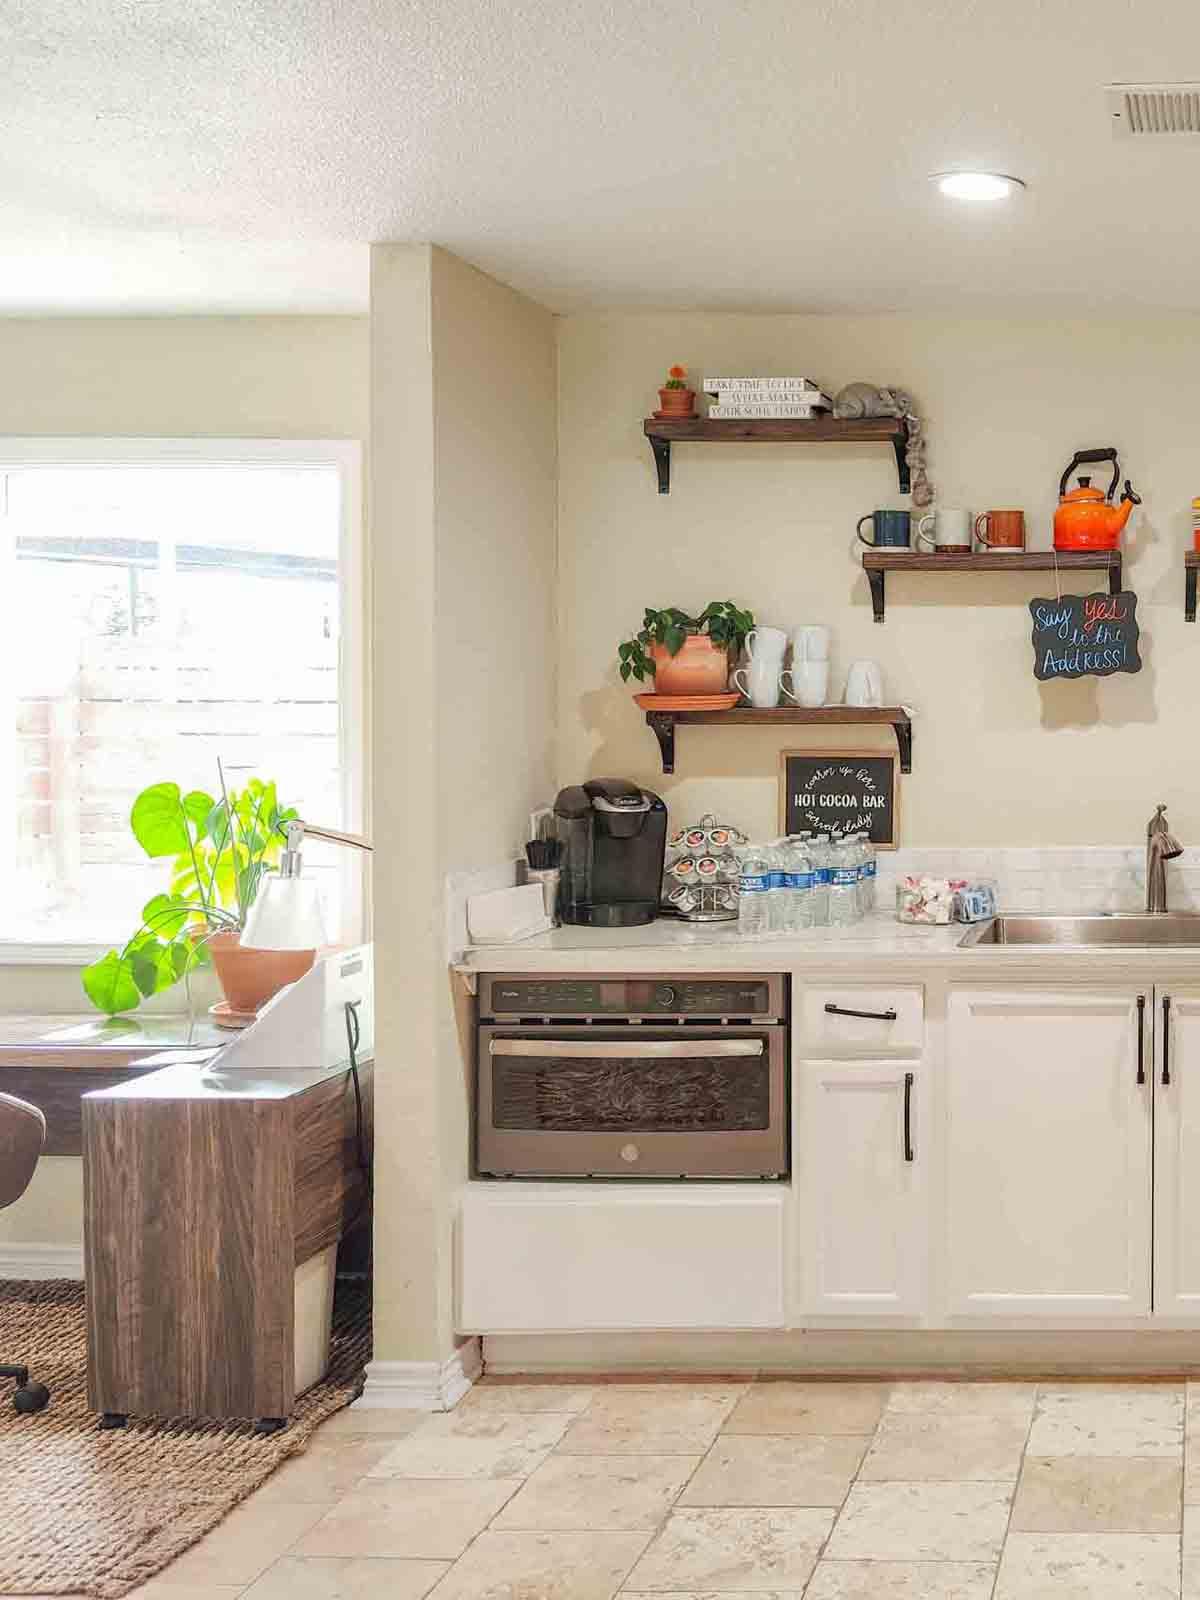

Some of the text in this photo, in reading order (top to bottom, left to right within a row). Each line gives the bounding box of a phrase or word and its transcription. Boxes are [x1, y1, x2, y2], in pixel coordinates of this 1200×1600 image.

[711, 406, 809, 417] YOUR SOUL HAPPY
[1036, 605, 1073, 640] Say
[1068, 623, 1122, 648] to the
[794, 793, 886, 808] HOT COCOA BAR
[805, 810, 873, 832] served daily
